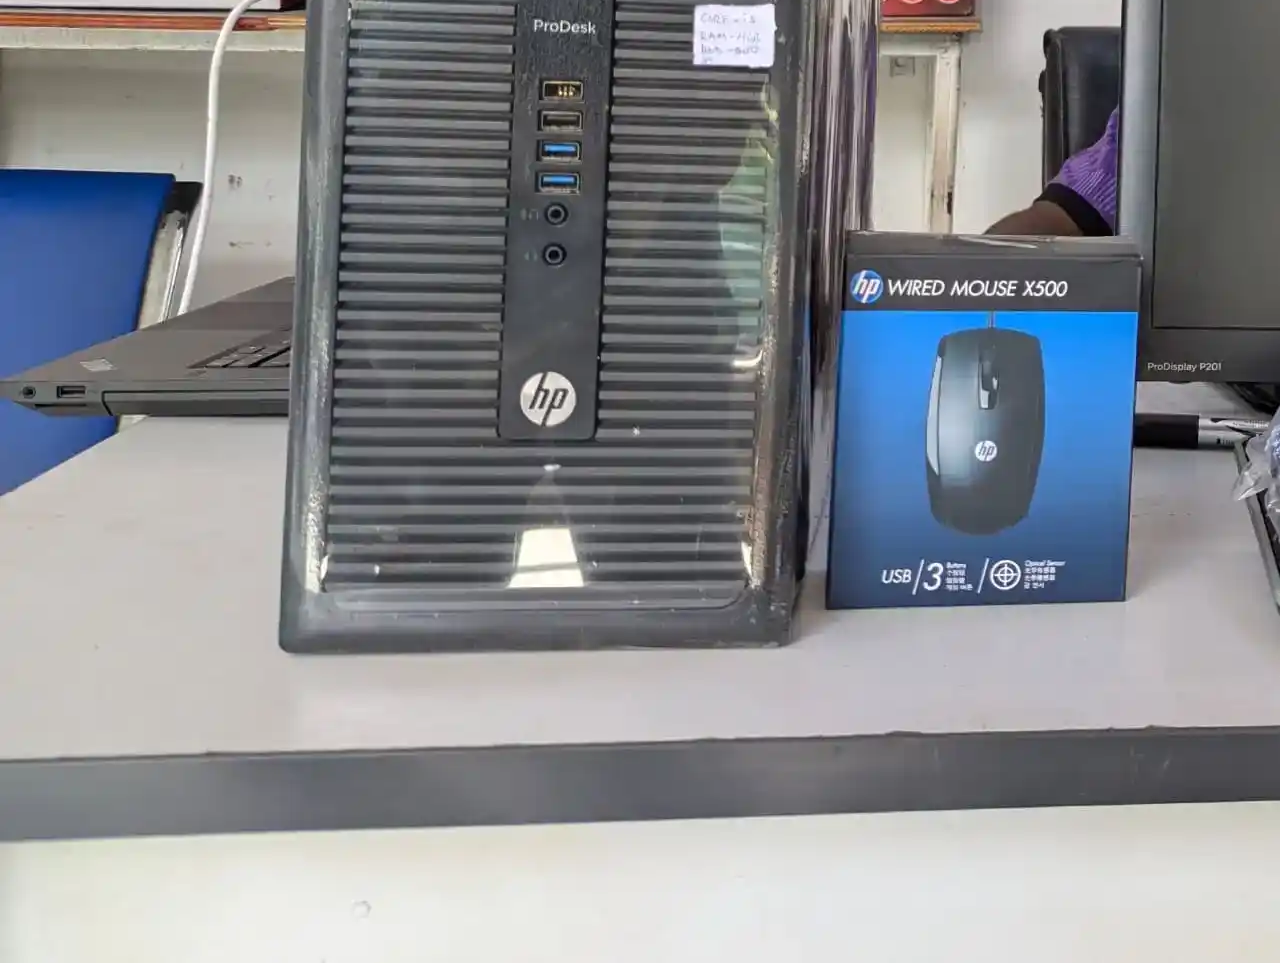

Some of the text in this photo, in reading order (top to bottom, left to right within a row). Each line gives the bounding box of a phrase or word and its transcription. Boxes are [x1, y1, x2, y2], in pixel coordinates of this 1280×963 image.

[533, 19, 596, 35] ProDesk
[851, 269, 1069, 303] hp WIRED MOUSE X500
[1147, 361, 1222, 373] ProDisplay P201
[527, 372, 571, 427] hp
[978, 440, 996, 462] hp
[881, 568, 912, 584] USB
[922, 561, 944, 591] 3
